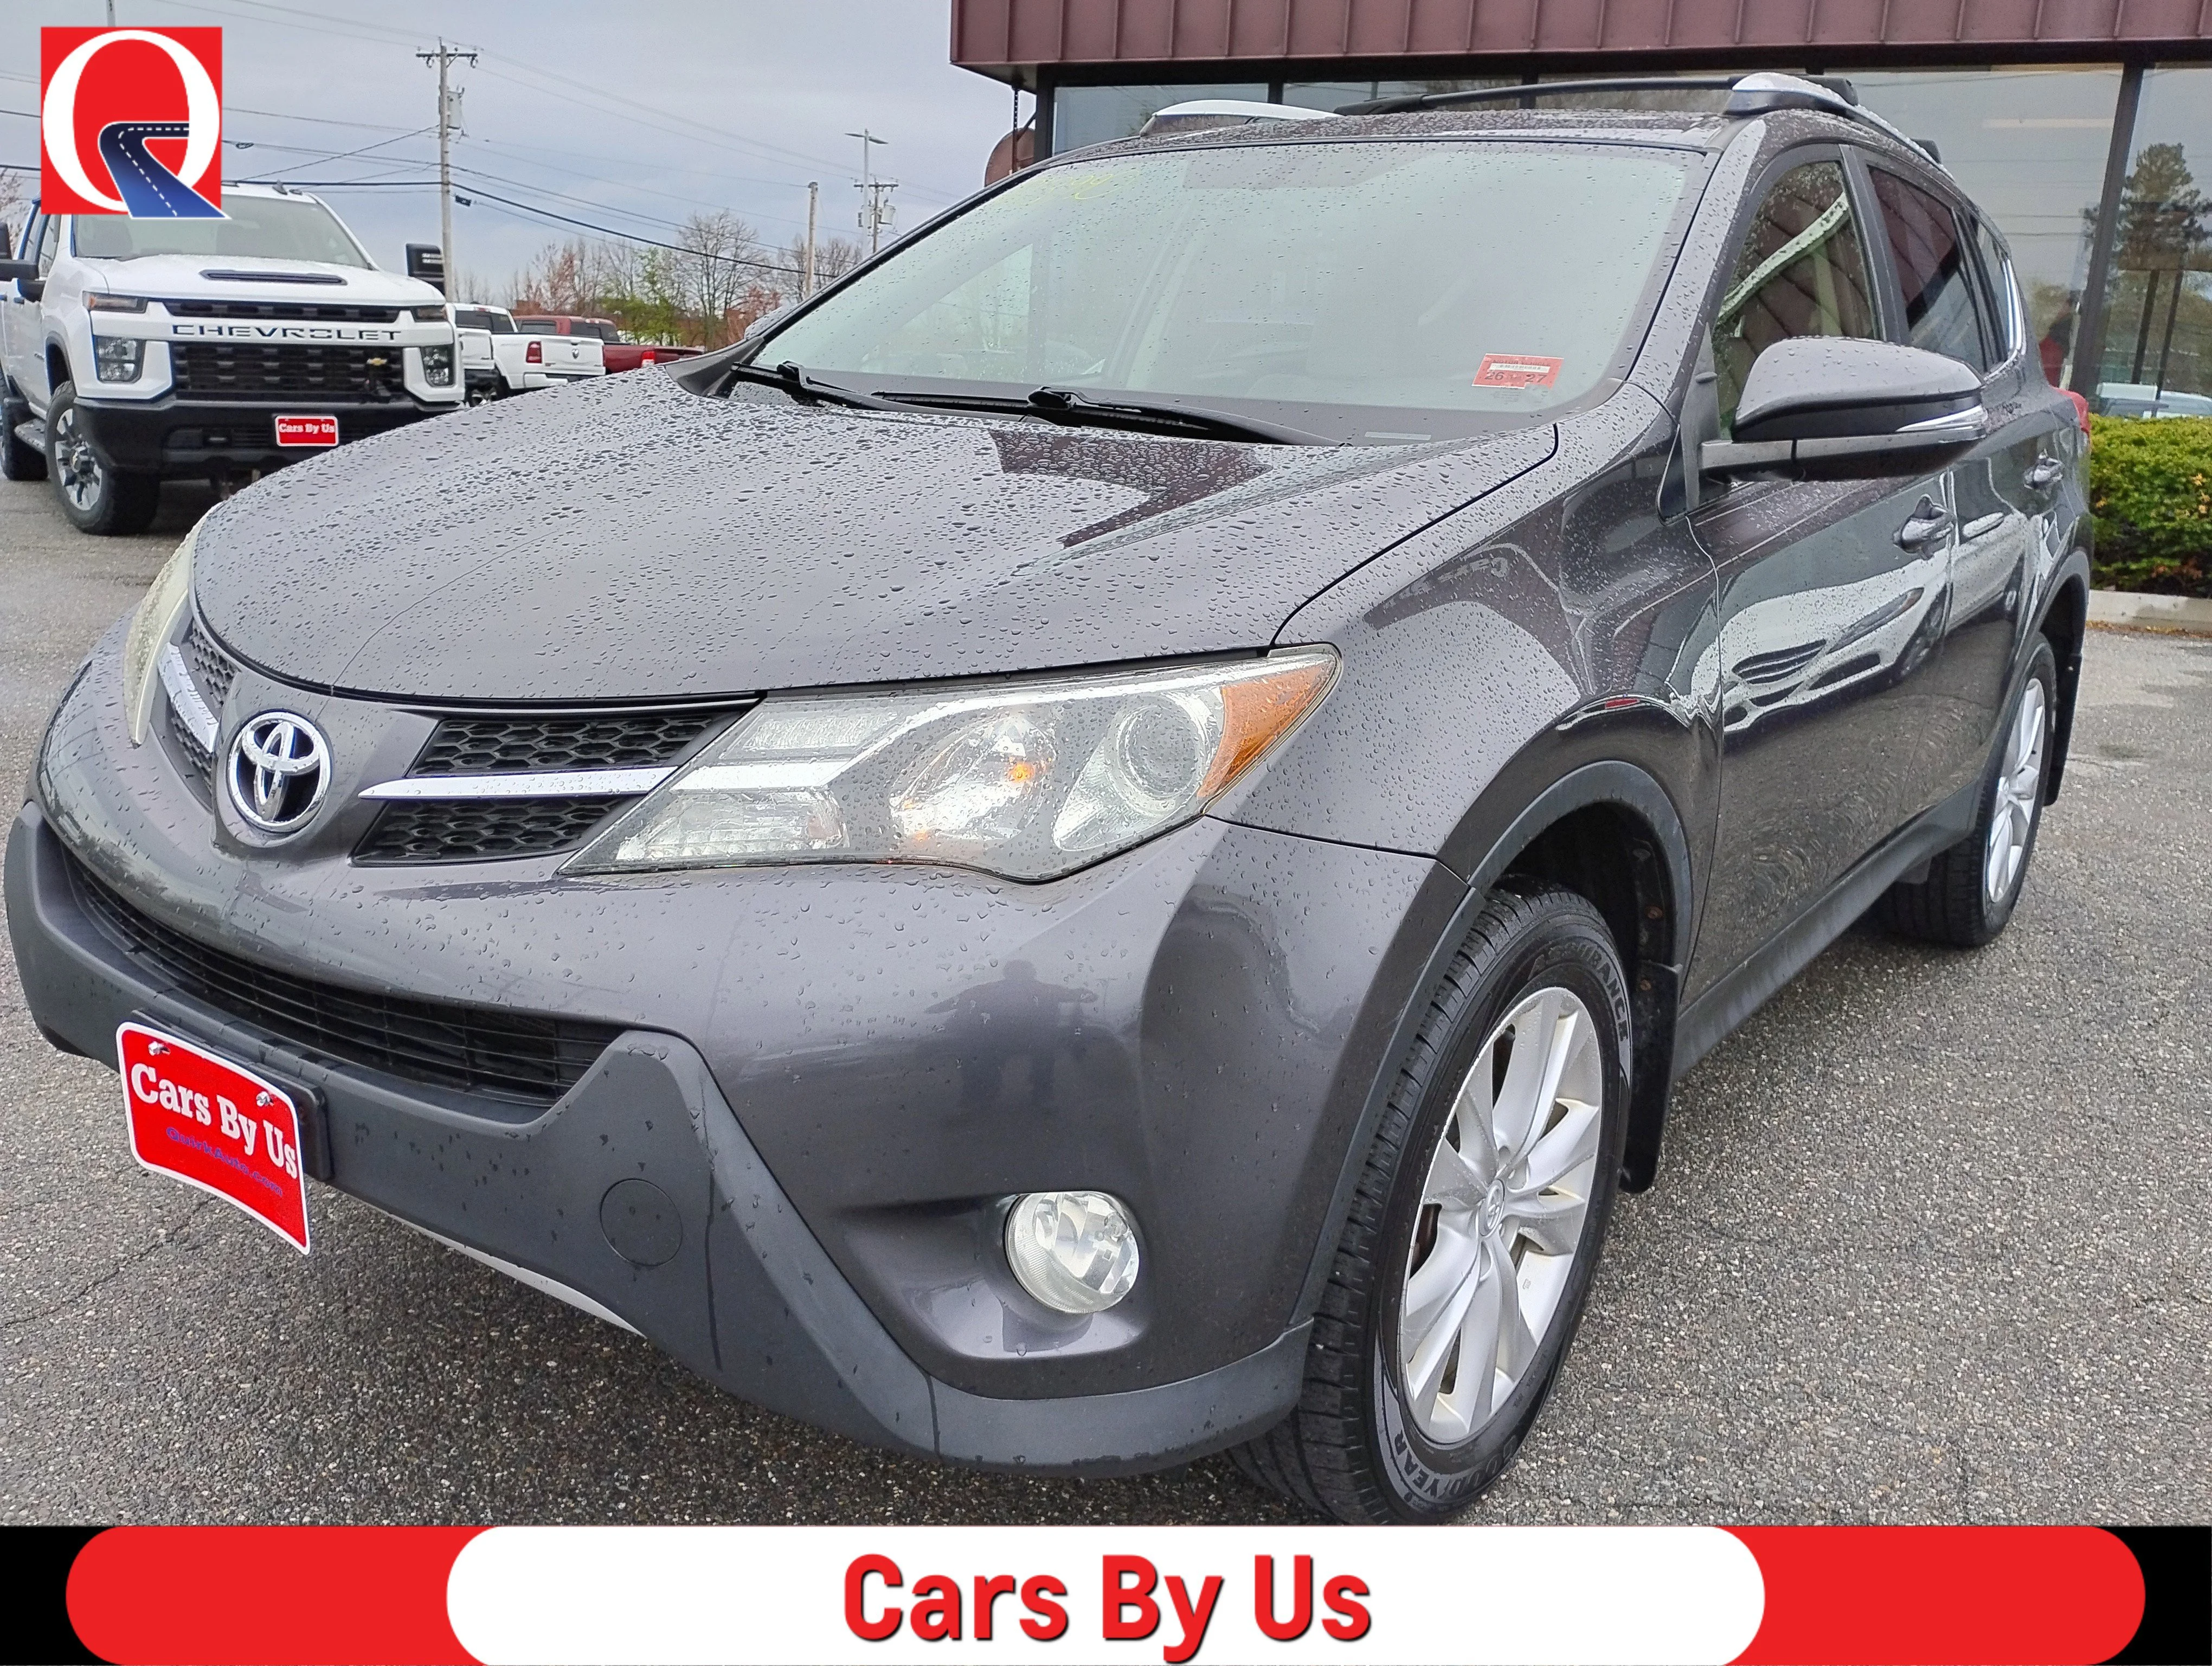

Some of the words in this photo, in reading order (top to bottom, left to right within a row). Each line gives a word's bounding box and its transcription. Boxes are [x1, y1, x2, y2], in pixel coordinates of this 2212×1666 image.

[172, 325, 401, 341] CHEVROLET
[1484, 371, 1504, 380] 26
[1525, 373, 1547, 383] 27
[279, 423, 304, 433] Cars
[305, 423, 320, 434] By
[321, 423, 335, 433] Us
[1528, 942, 1629, 1042] ASSURANCE
[131, 1063, 211, 1126] Cars
[217, 1094, 257, 1156] By
[263, 1120, 298, 1180] Us
[166, 1126, 284, 1197] QuirkAuto.com
